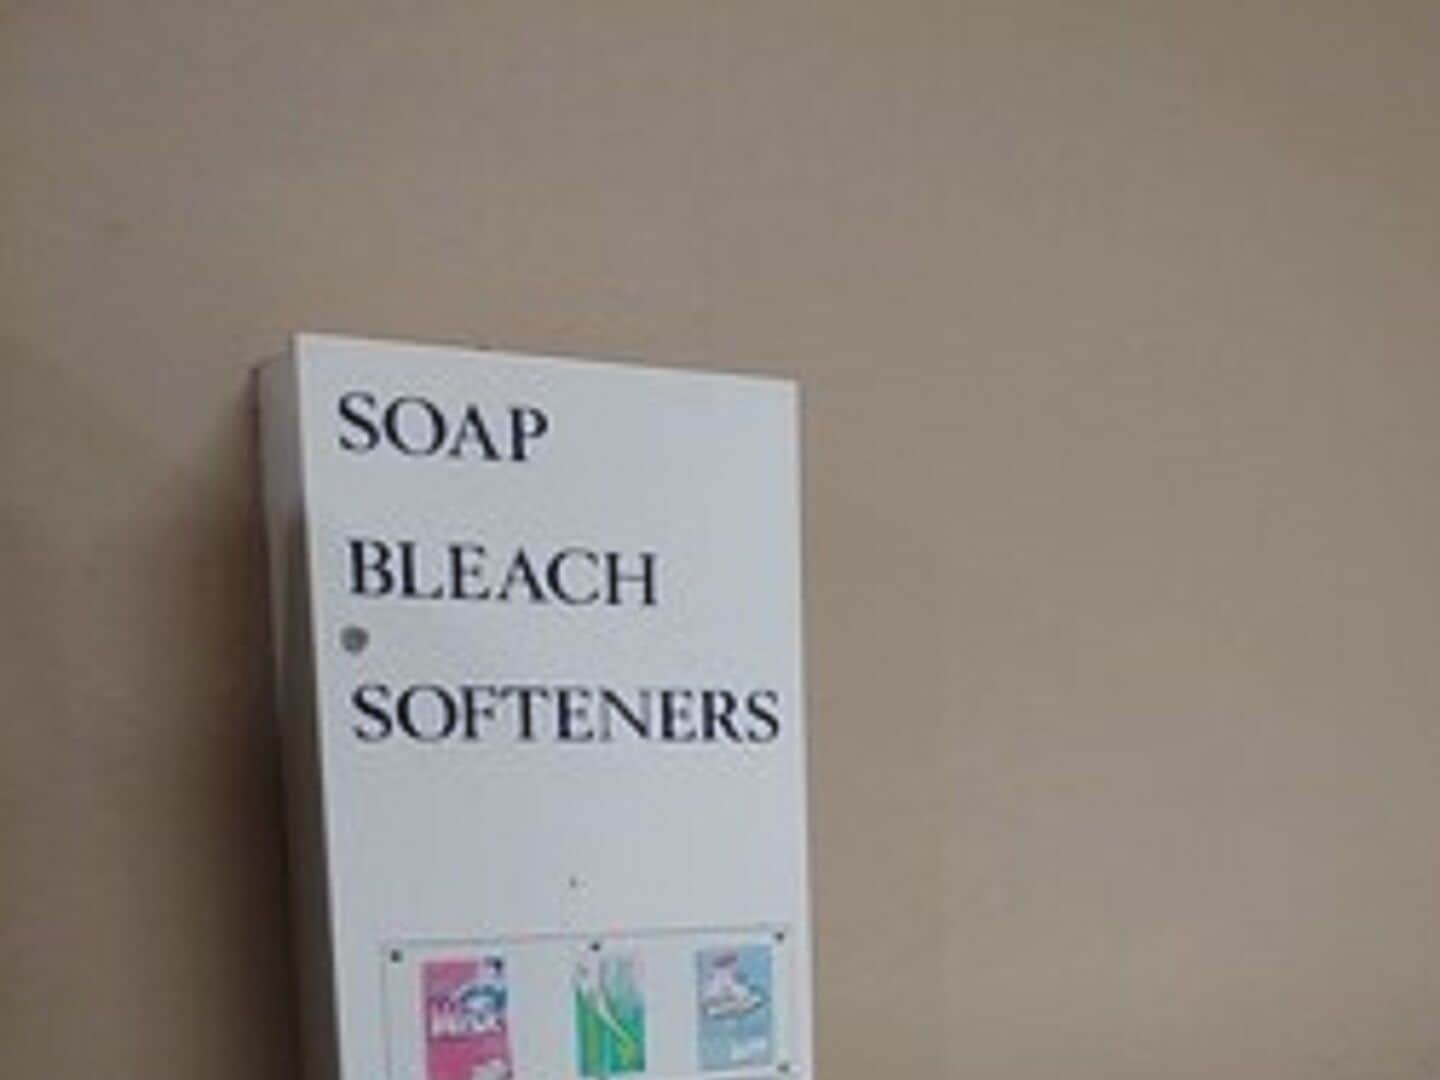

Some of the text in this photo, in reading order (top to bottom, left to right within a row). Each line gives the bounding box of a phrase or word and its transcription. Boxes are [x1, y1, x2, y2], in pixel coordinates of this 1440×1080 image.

[337, 391, 549, 462] SOAP
[348, 538, 659, 606] BLEACH
[353, 684, 781, 744] SOFTENERS
